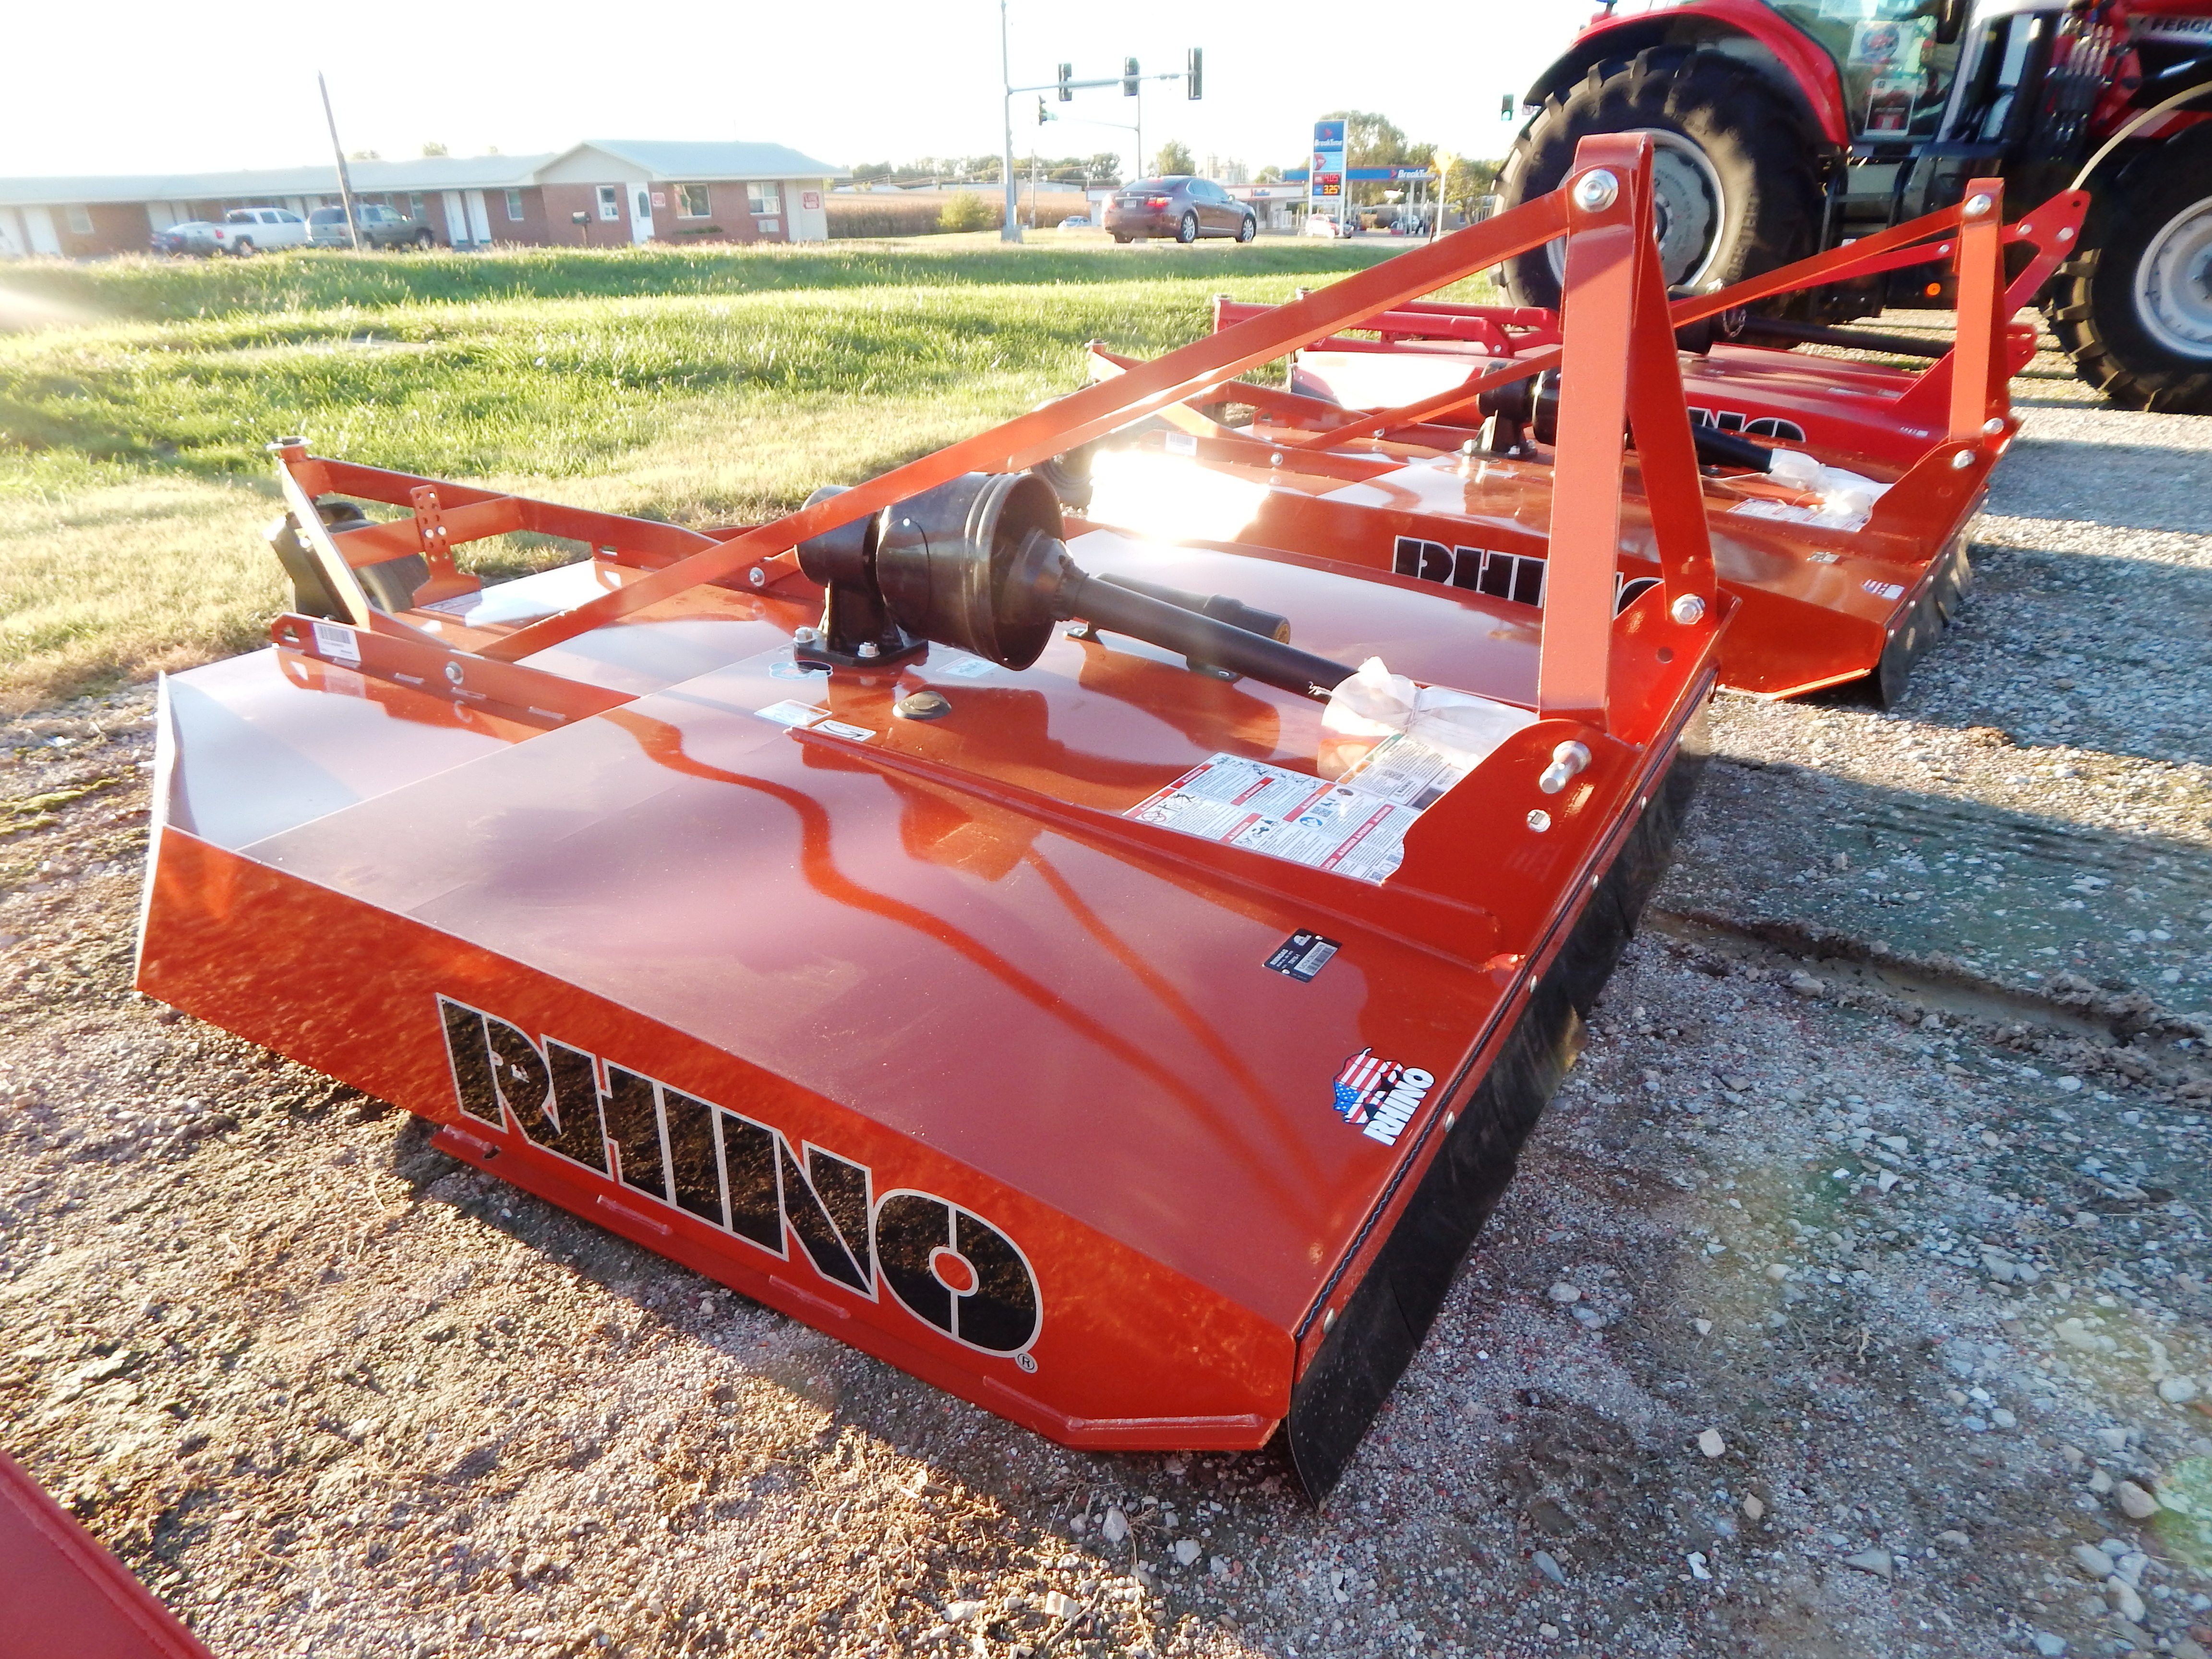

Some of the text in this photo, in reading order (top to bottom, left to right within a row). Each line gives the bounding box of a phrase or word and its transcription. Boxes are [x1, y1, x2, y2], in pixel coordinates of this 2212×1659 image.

[1231, 821, 1251, 837] DANGER
[1340, 838, 1358, 853] DANGER
[1362, 1067, 1435, 1146] RHINO
[435, 992, 1044, 1358] RHINO
